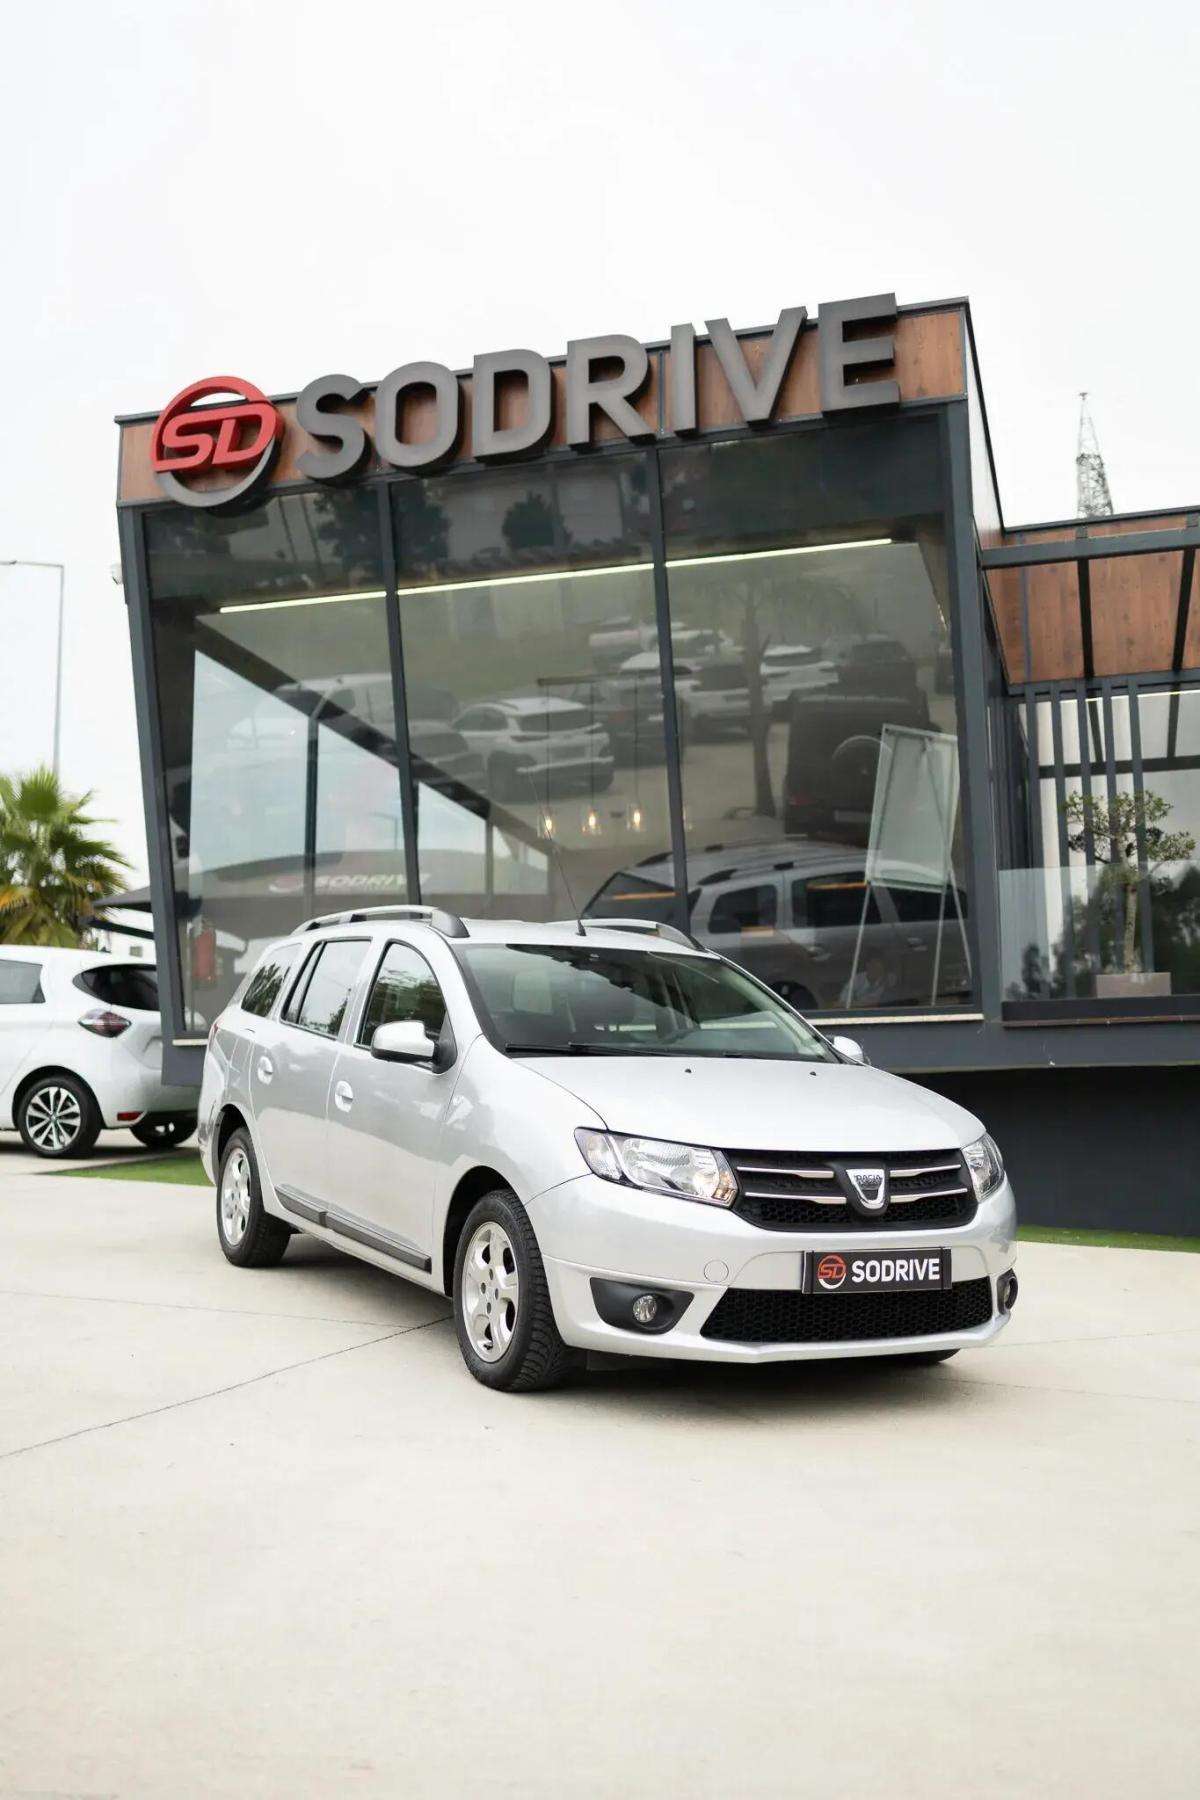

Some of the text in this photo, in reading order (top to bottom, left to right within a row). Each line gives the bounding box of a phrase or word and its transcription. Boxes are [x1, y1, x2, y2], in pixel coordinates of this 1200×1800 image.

[151, 293, 900, 479] SD SODRIVE
[818, 1258, 940, 1283] SD SODRIVE
